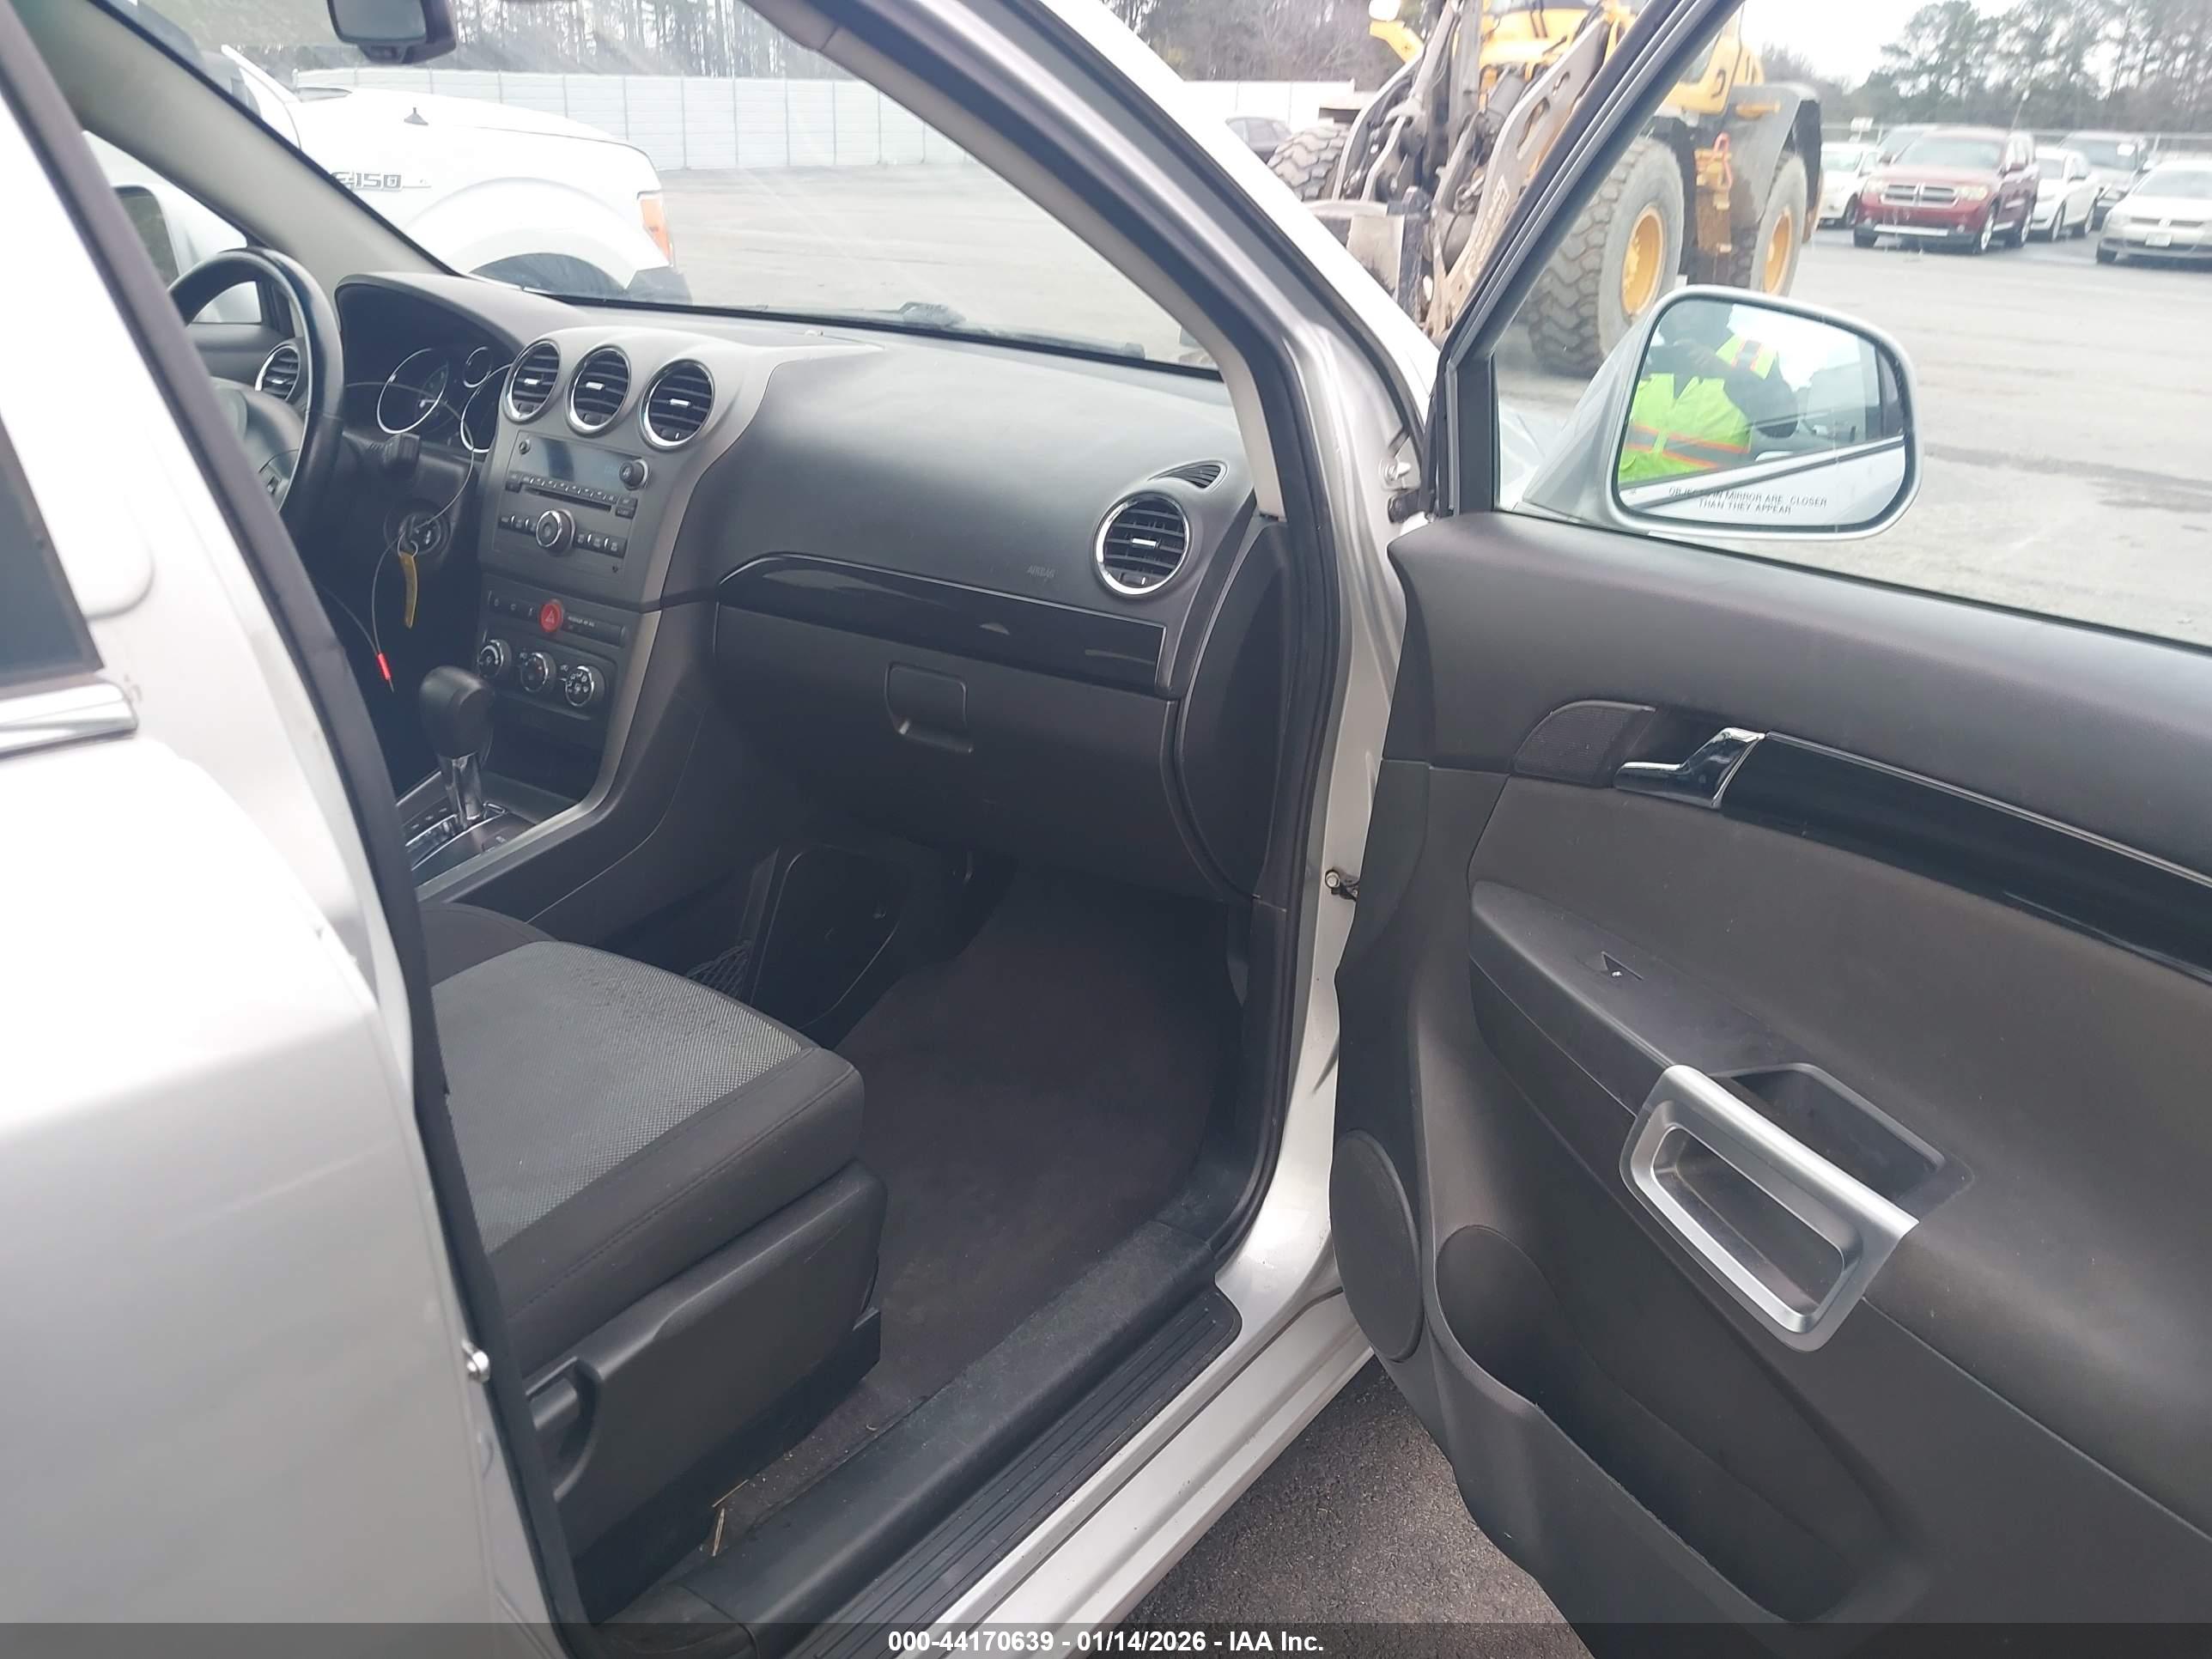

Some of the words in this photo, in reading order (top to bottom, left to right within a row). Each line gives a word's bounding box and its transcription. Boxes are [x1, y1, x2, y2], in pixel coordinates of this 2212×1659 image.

[1668, 486, 1709, 497] OBJEC
[1724, 491, 1762, 502] MIRROR
[1764, 494, 1783, 504] ARE
[1789, 495, 1827, 507] CLOSER
[1698, 499, 1725, 509] THAN
[1728, 501, 1753, 513] THEY
[1754, 504, 1792, 514] APPEAR
